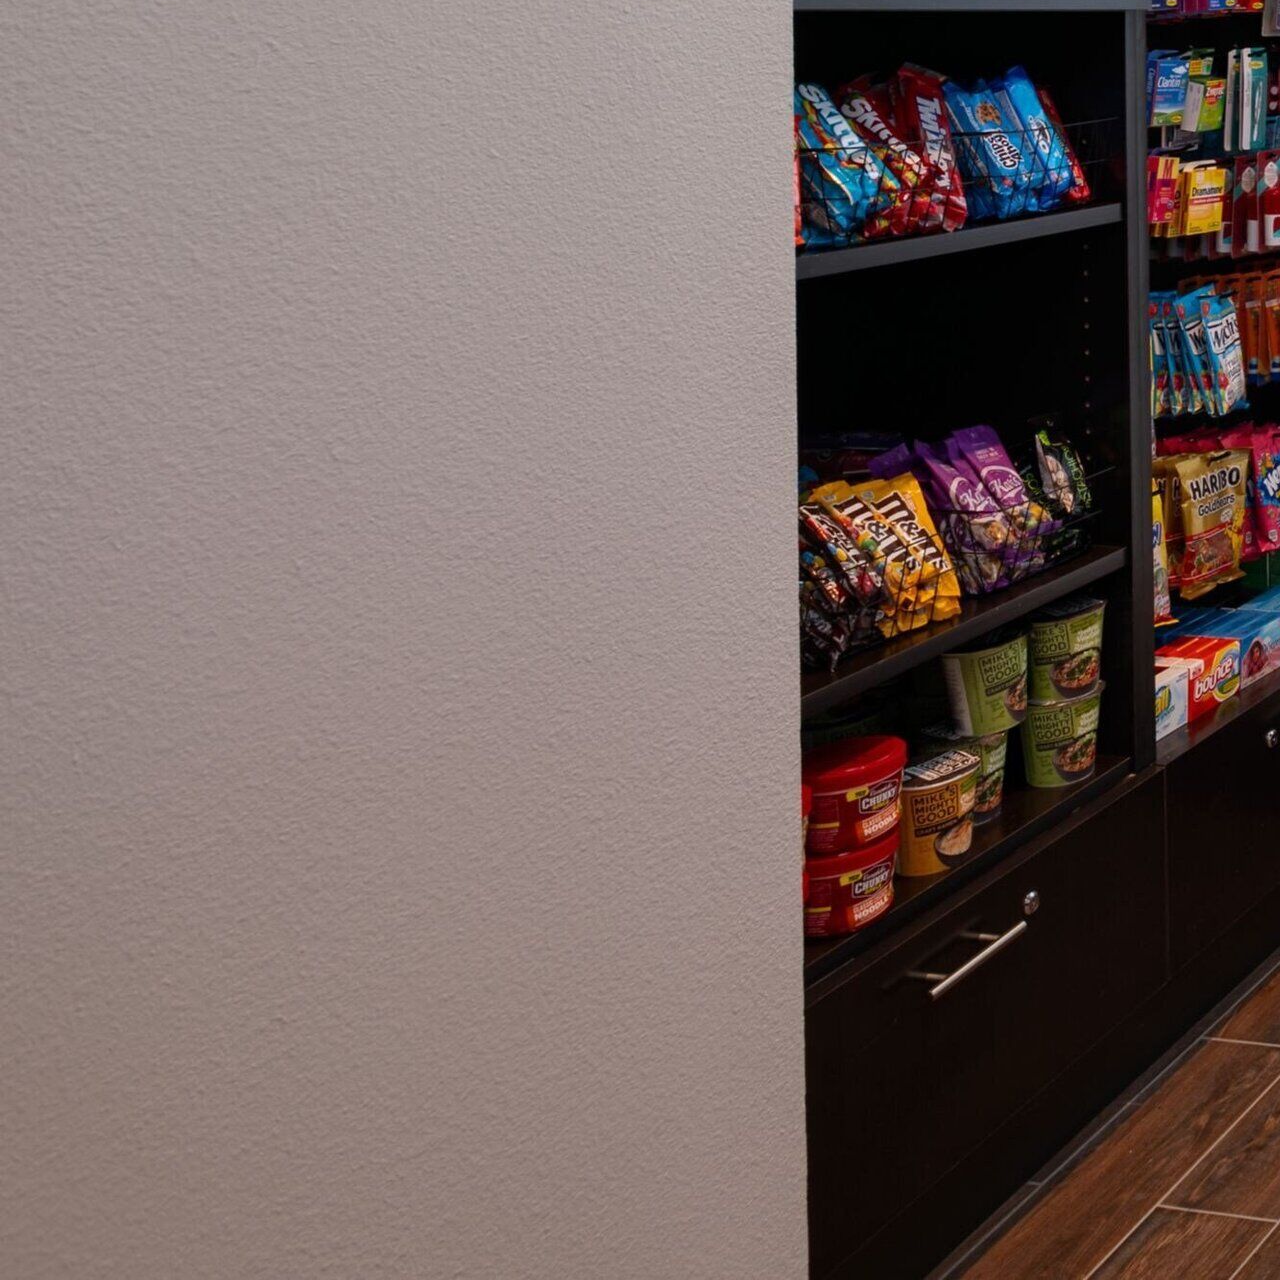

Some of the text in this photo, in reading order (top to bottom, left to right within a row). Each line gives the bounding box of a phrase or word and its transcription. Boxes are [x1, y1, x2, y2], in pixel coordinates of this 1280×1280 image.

[1189, 467, 1240, 501] HARIBO
[985, 662, 1018, 684] GOOD
[1194, 656, 1234, 701] bounce
[1036, 727, 1071, 740] GOOD
[861, 787, 897, 810] CHUNKY
[914, 784, 955, 806] MIKE'S
[914, 798, 957, 817] MIGHTY
[916, 805, 956, 825] GOOD
[863, 811, 899, 836] NOODLE
[853, 871, 889, 895] CHUNKY
[853, 895, 889, 920] NOODLE
